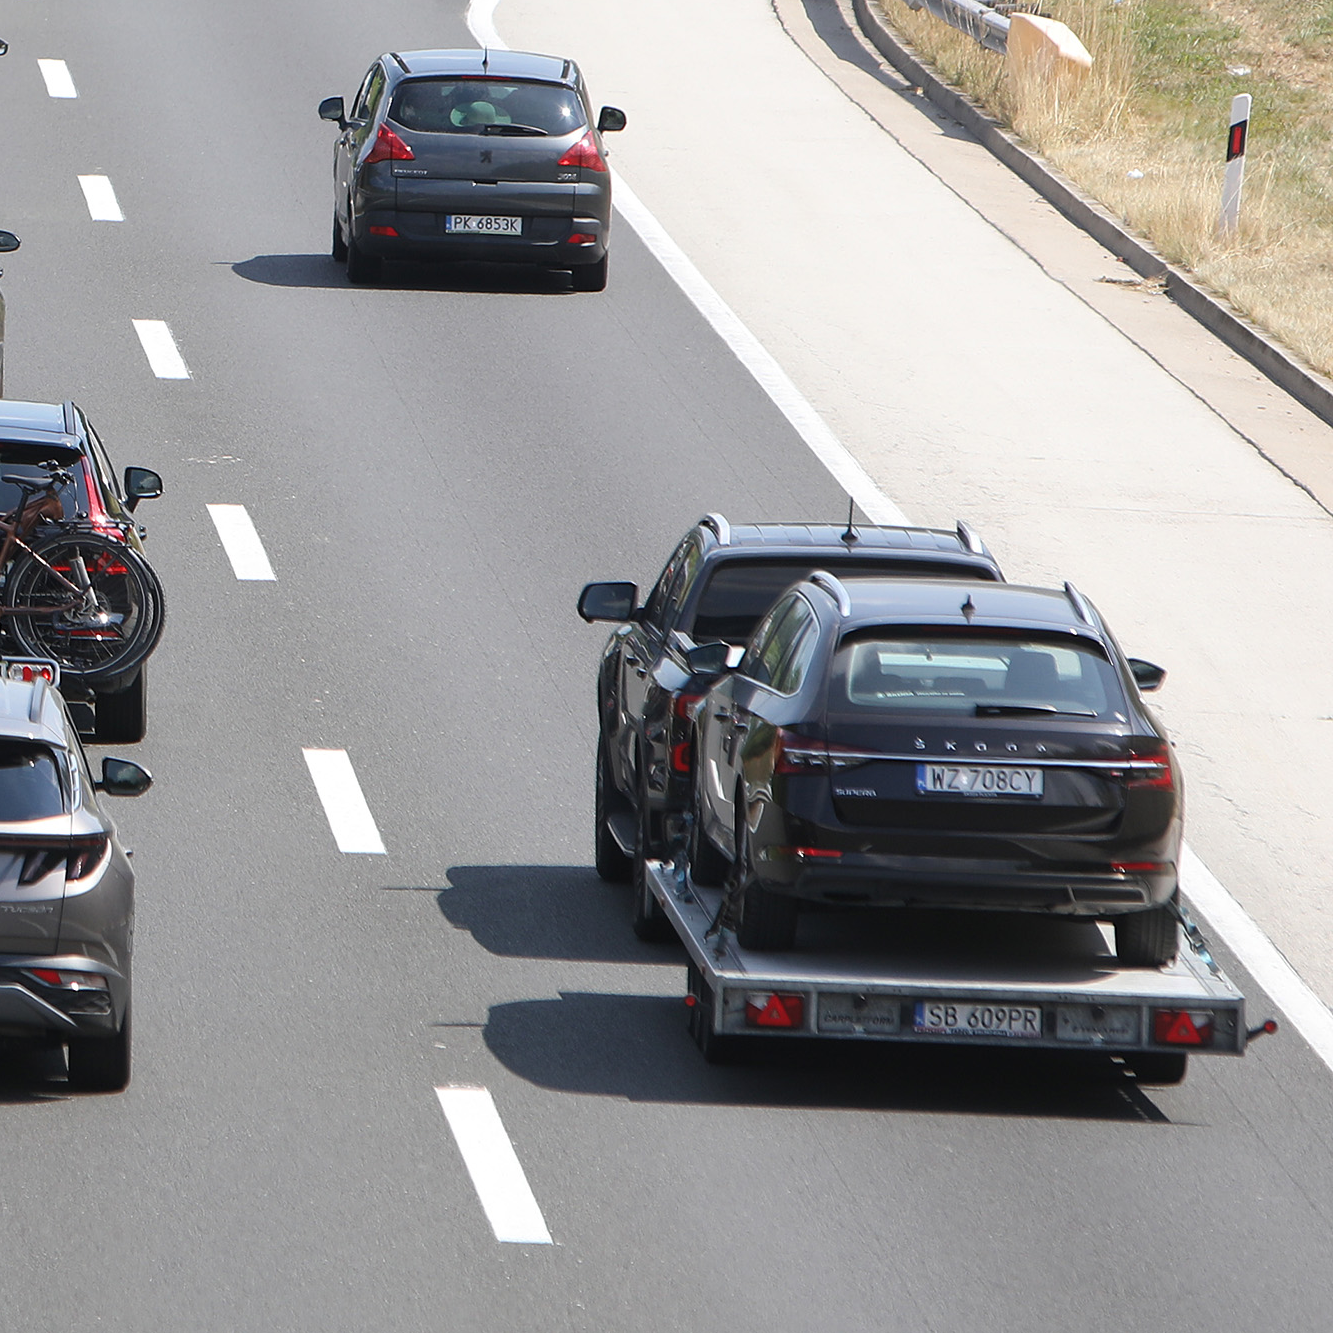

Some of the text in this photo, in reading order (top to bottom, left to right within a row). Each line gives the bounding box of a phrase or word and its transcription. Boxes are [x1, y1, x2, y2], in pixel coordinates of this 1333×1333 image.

[453, 216, 518, 232] PK 6853K
[932, 767, 1037, 793] WZ 708CY
[929, 1005, 1037, 1031] SB 609PR
